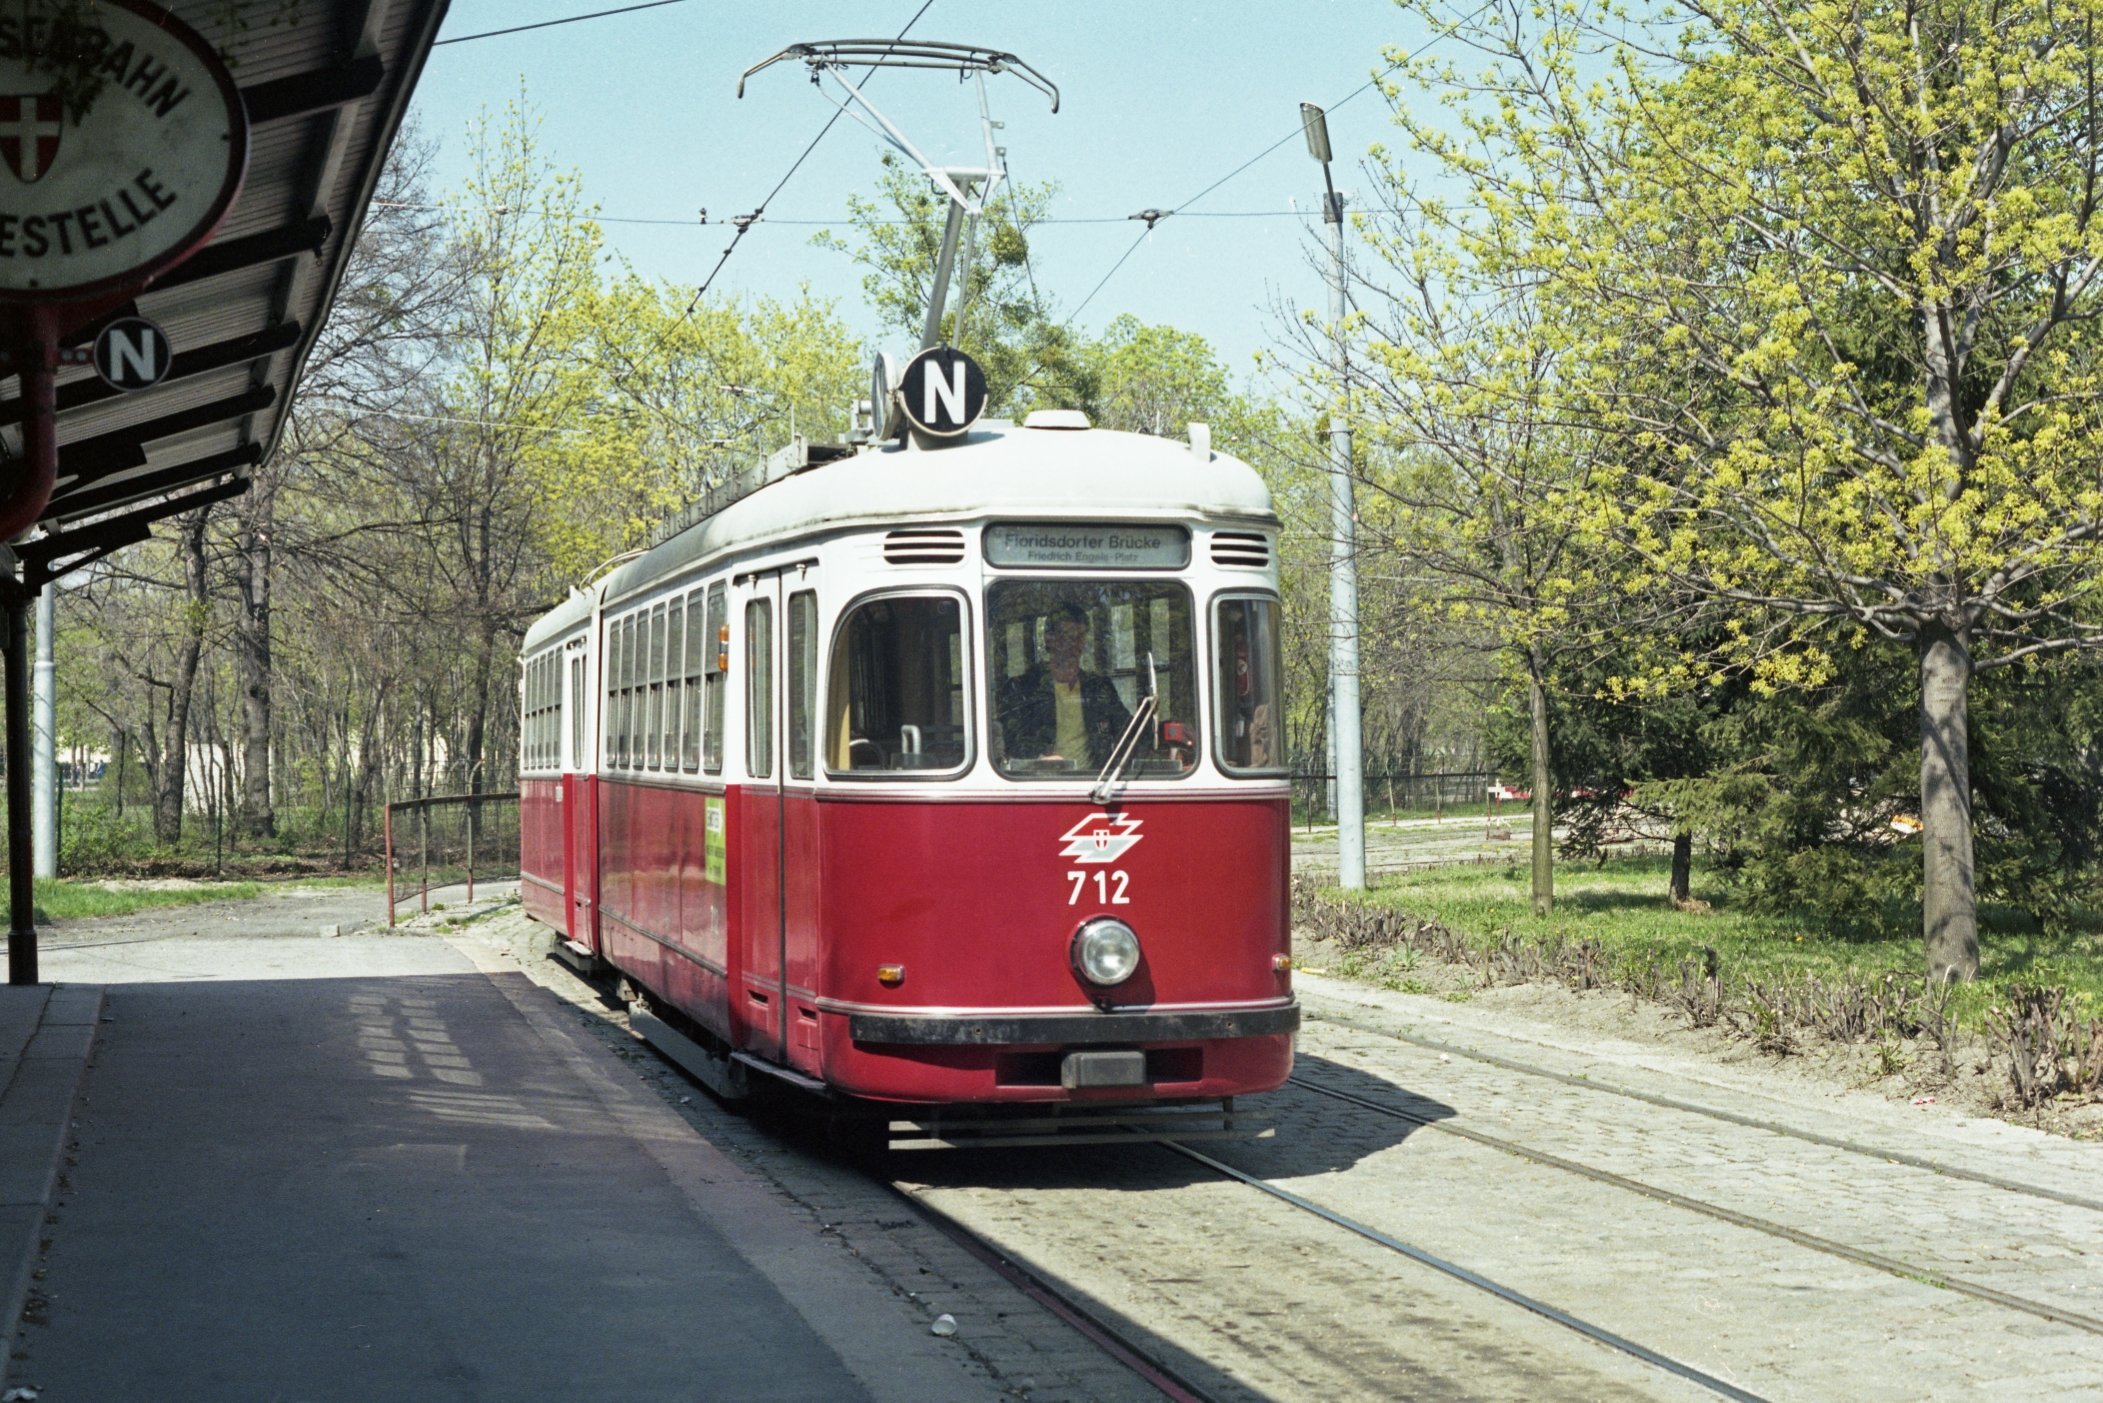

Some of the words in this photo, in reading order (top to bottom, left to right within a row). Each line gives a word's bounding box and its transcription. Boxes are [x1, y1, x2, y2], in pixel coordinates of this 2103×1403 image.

[0, 15, 191, 118] SEBAHN
[109, 328, 156, 382] N
[924, 360, 966, 425] N
[1005, 533, 1104, 549] Floridsdorfer
[1108, 533, 1161, 549] Brücke
[1027, 550, 1072, 561] Friedrich
[1067, 870, 1130, 905] 712
